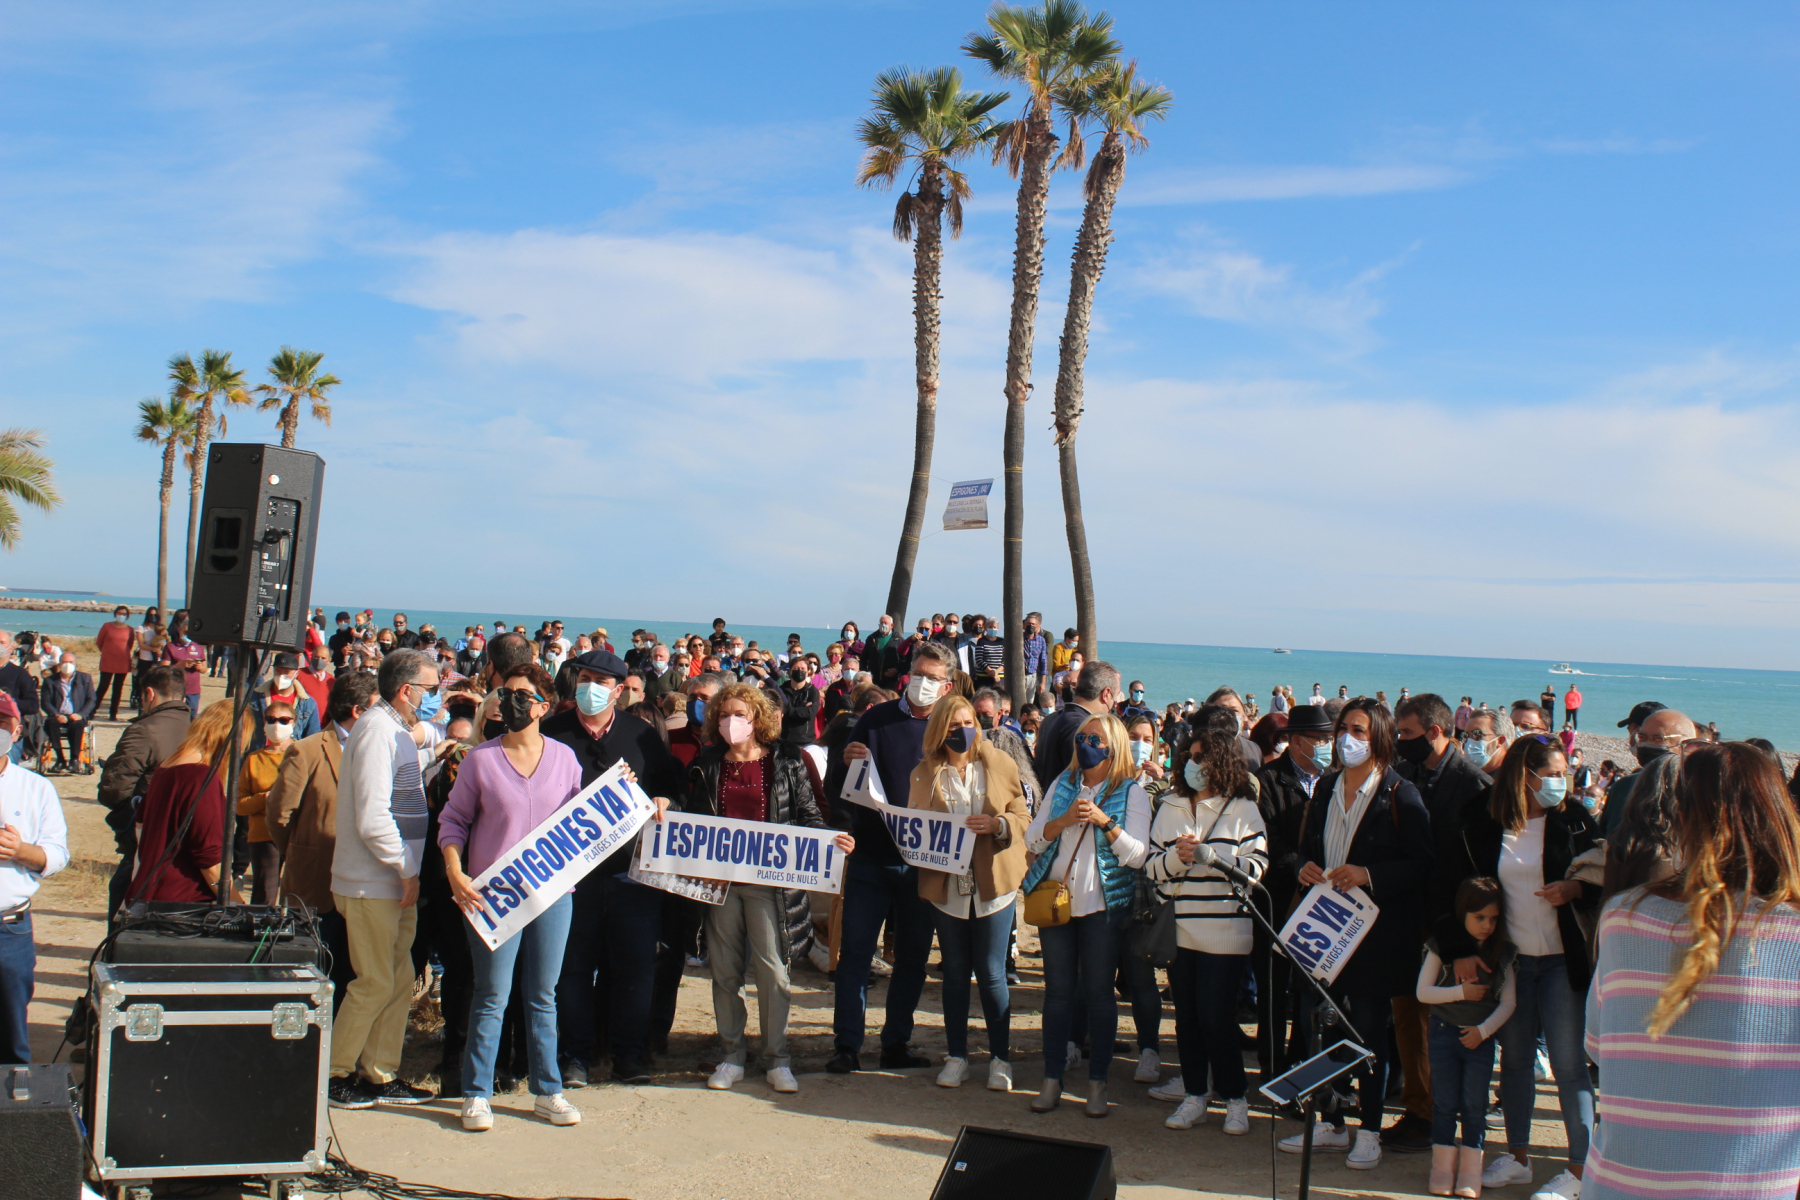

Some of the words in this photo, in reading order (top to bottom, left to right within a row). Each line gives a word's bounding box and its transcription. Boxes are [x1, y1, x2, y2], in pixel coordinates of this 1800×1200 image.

[583, 840, 612, 864] PLATGES
[610, 832, 622, 843] DE
[619, 814, 638, 835] NULES
[920, 851, 929, 862] DE
[929, 853, 949, 866] NULES
[757, 869, 784, 882] PLATGES
[786, 872, 796, 883] DE
[796, 873, 818, 885] NULES
[1320, 945, 1344, 973] PLATGES
[1337, 935, 1351, 949] DE
[1344, 916, 1365, 940] NULES
